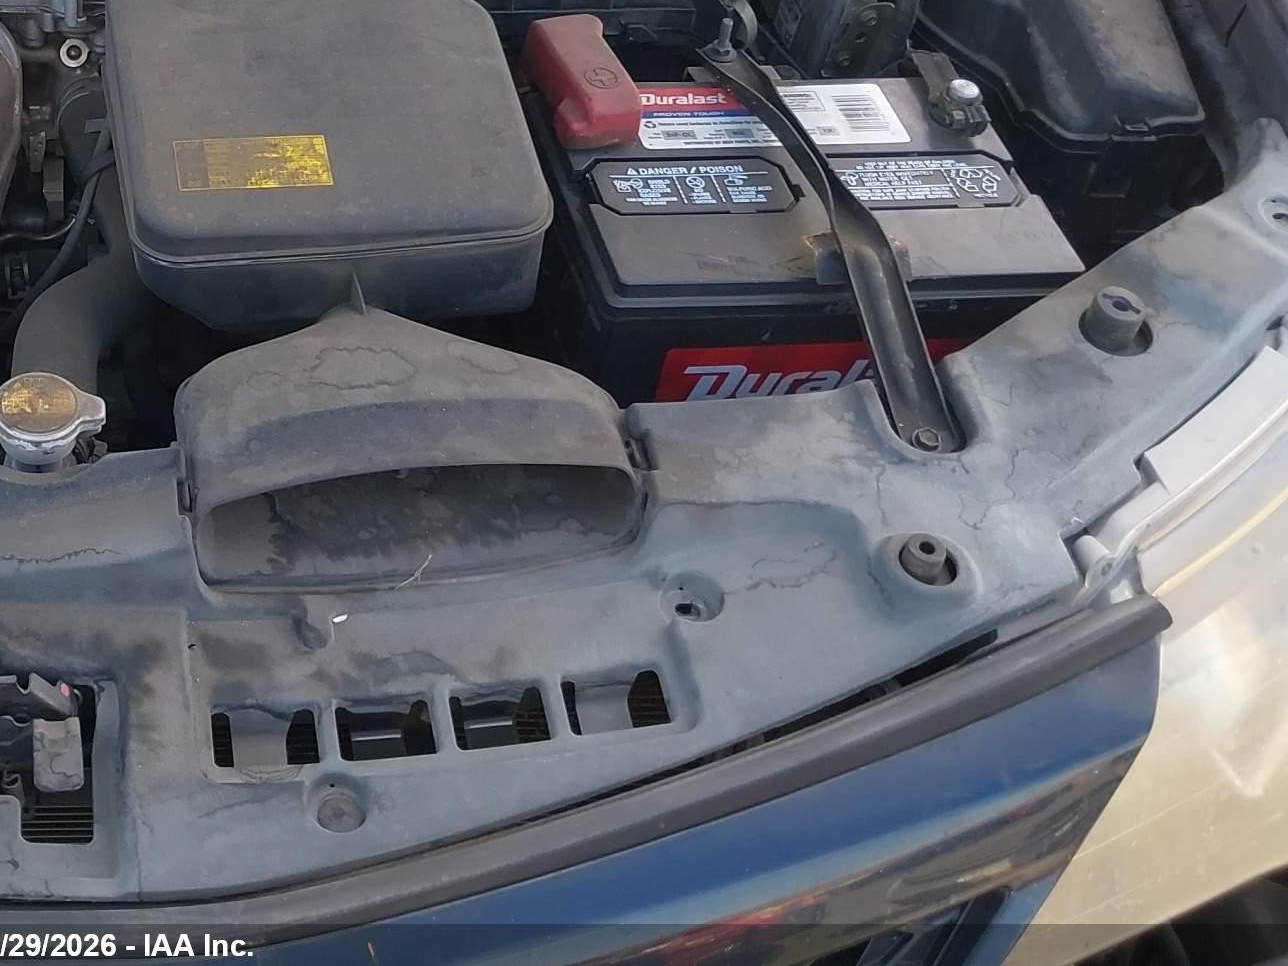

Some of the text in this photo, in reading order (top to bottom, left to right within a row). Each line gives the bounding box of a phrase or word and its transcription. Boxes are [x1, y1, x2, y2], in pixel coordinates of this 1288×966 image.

[639, 92, 728, 106] Duralast
[638, 167, 688, 175] DANGER
[698, 165, 744, 173] POISON
